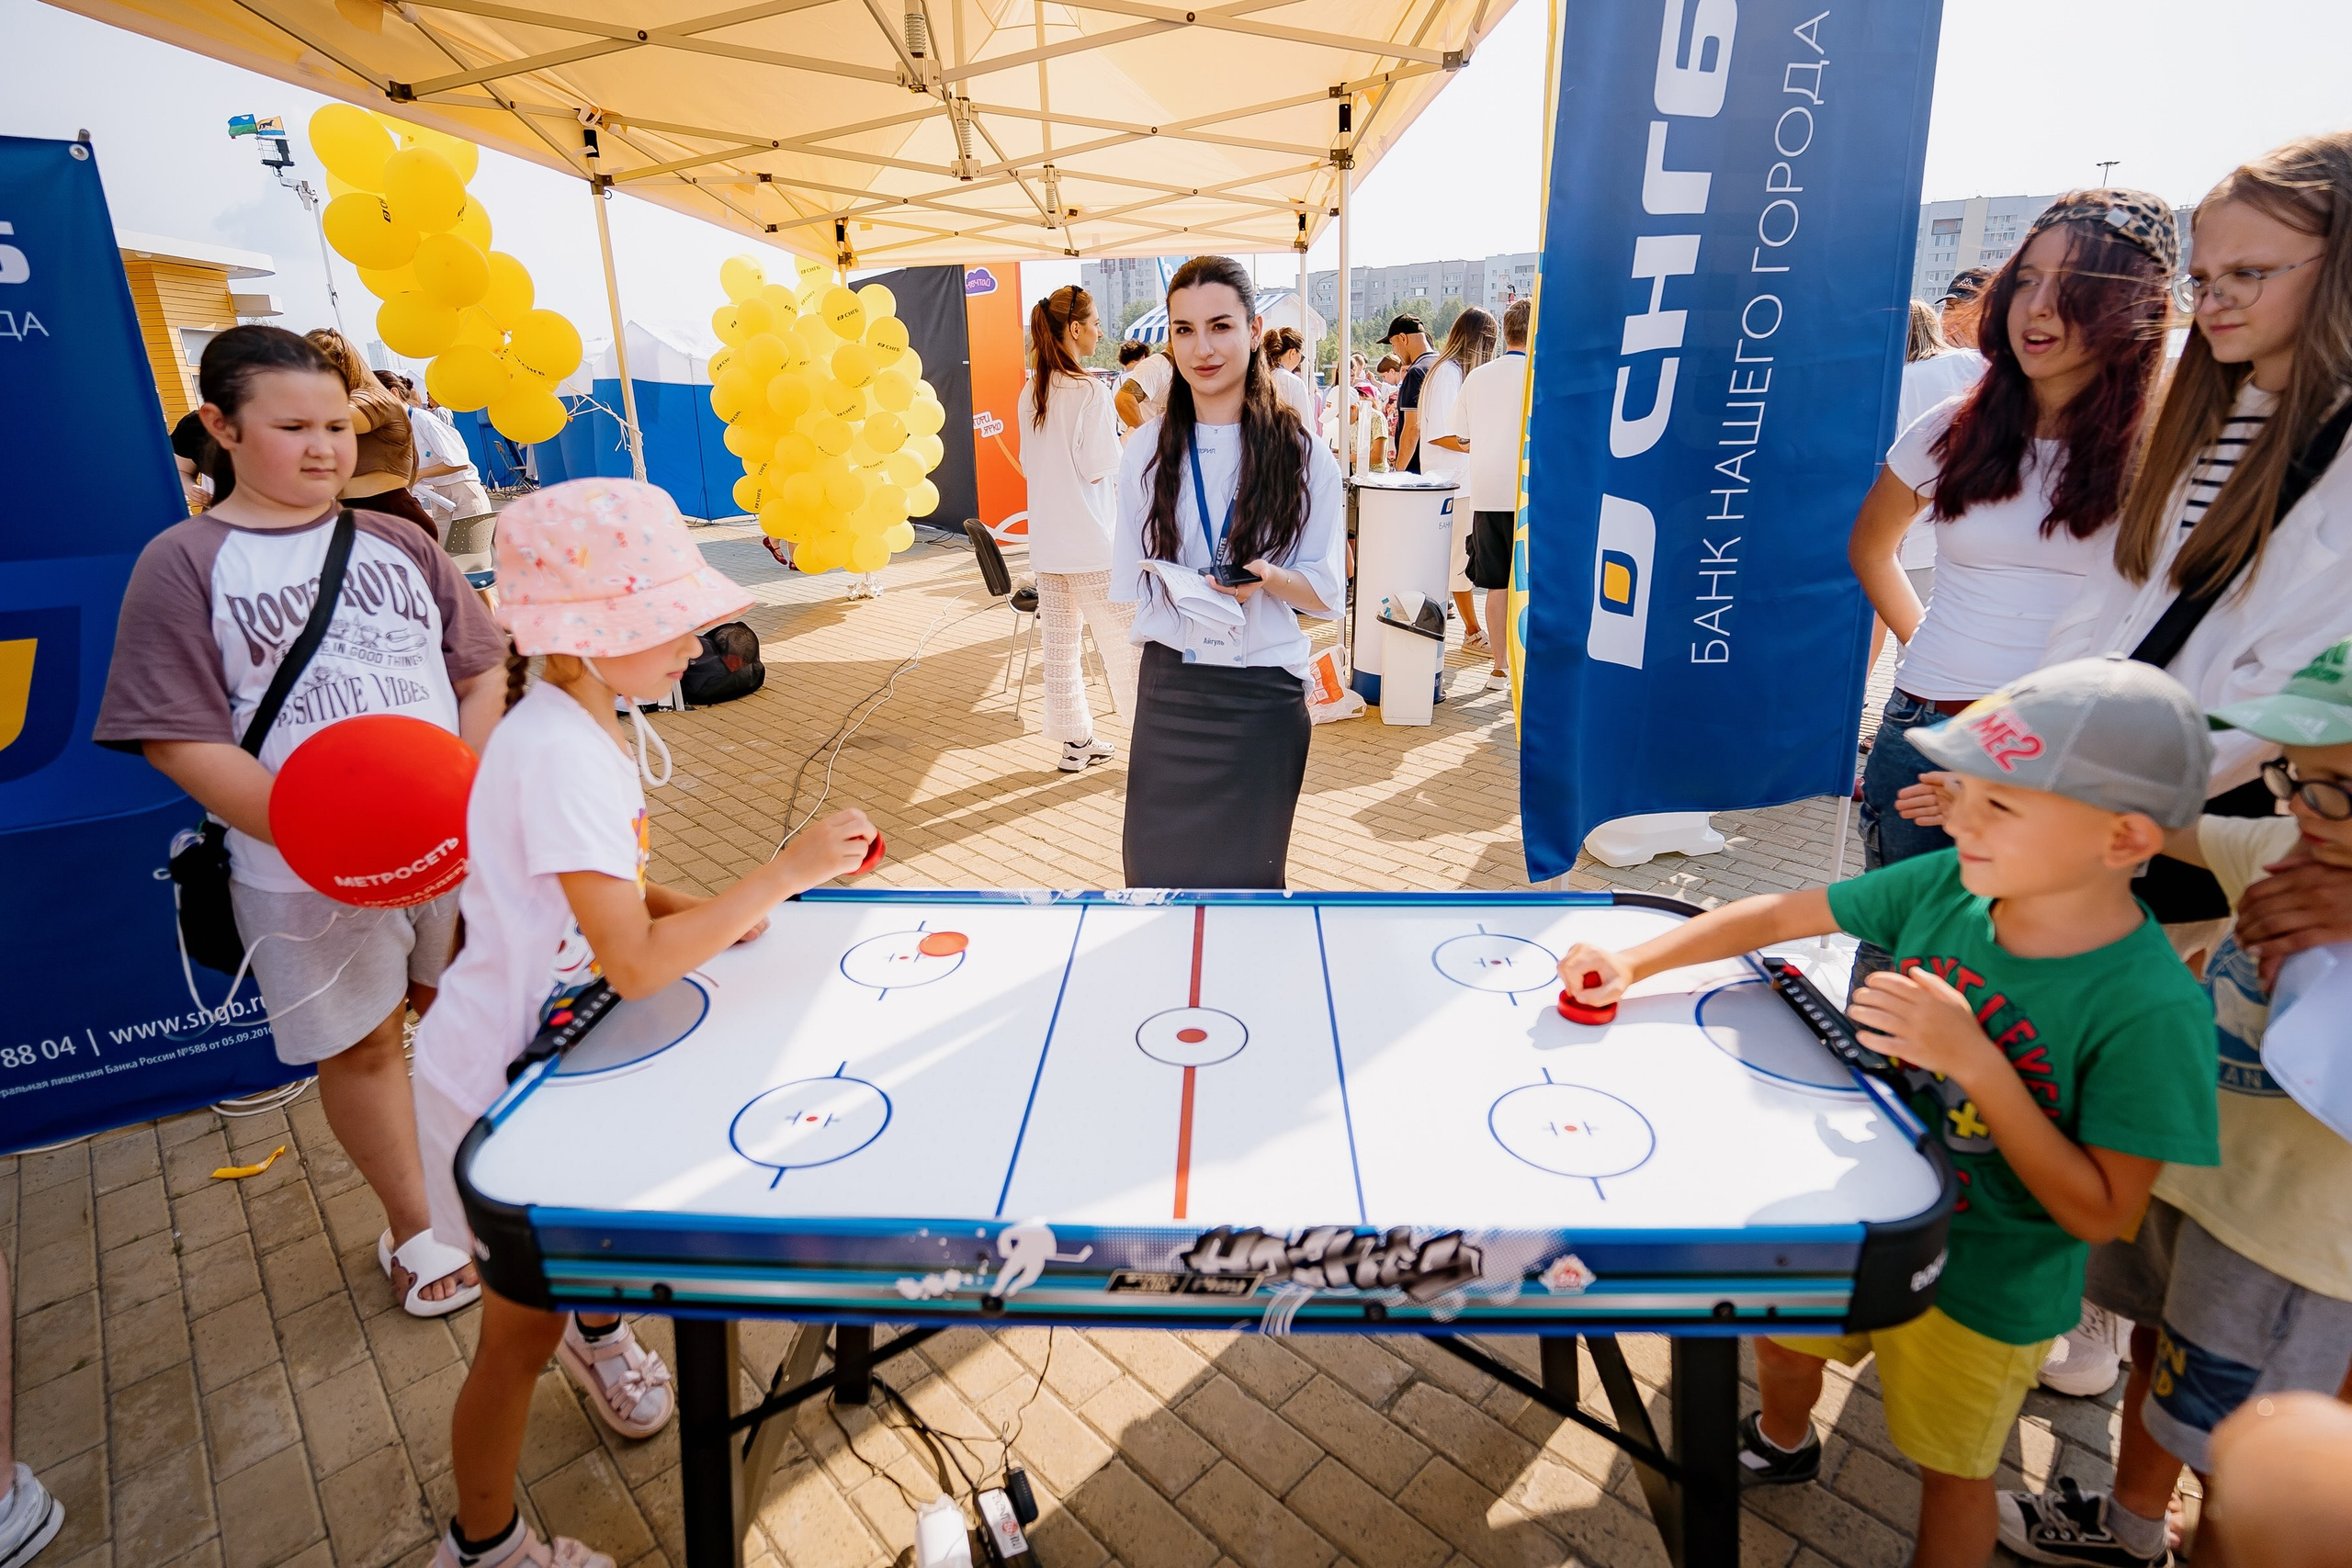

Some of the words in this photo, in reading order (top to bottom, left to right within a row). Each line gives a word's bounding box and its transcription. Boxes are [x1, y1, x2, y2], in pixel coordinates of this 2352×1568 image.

[1751, 10, 1830, 273] ГОРОДА
[1610, 0, 1738, 458] СНГБ
[844, 308, 860, 319] СНГБ
[885, 344, 900, 353] СНГБ
[1706, 294, 1783, 520] НАШЕГО
[1216, 536, 1227, 560] СНГБ
[1690, 536, 1742, 664] БАНК
[333, 643, 345, 654] IN
[349, 646, 383, 664] GOOD
[1203, 637, 1226, 648] Айгуль
[369, 672, 431, 708] VIBES
[334, 837, 460, 888] МЕТРОСЕТЬ
[1898, 957, 1986, 995] EXT
[0, 1044, 37, 1068] 88
[40, 1035, 77, 1060] 04
[0, 1080, 50, 1100] ральная
[51, 1068, 104, 1087] лицензия
[105, 1060, 139, 1075] Банка
[139, 1052, 176, 1066] России
[177, 1043, 209, 1058] №588
[209, 1041, 220, 1051] от
